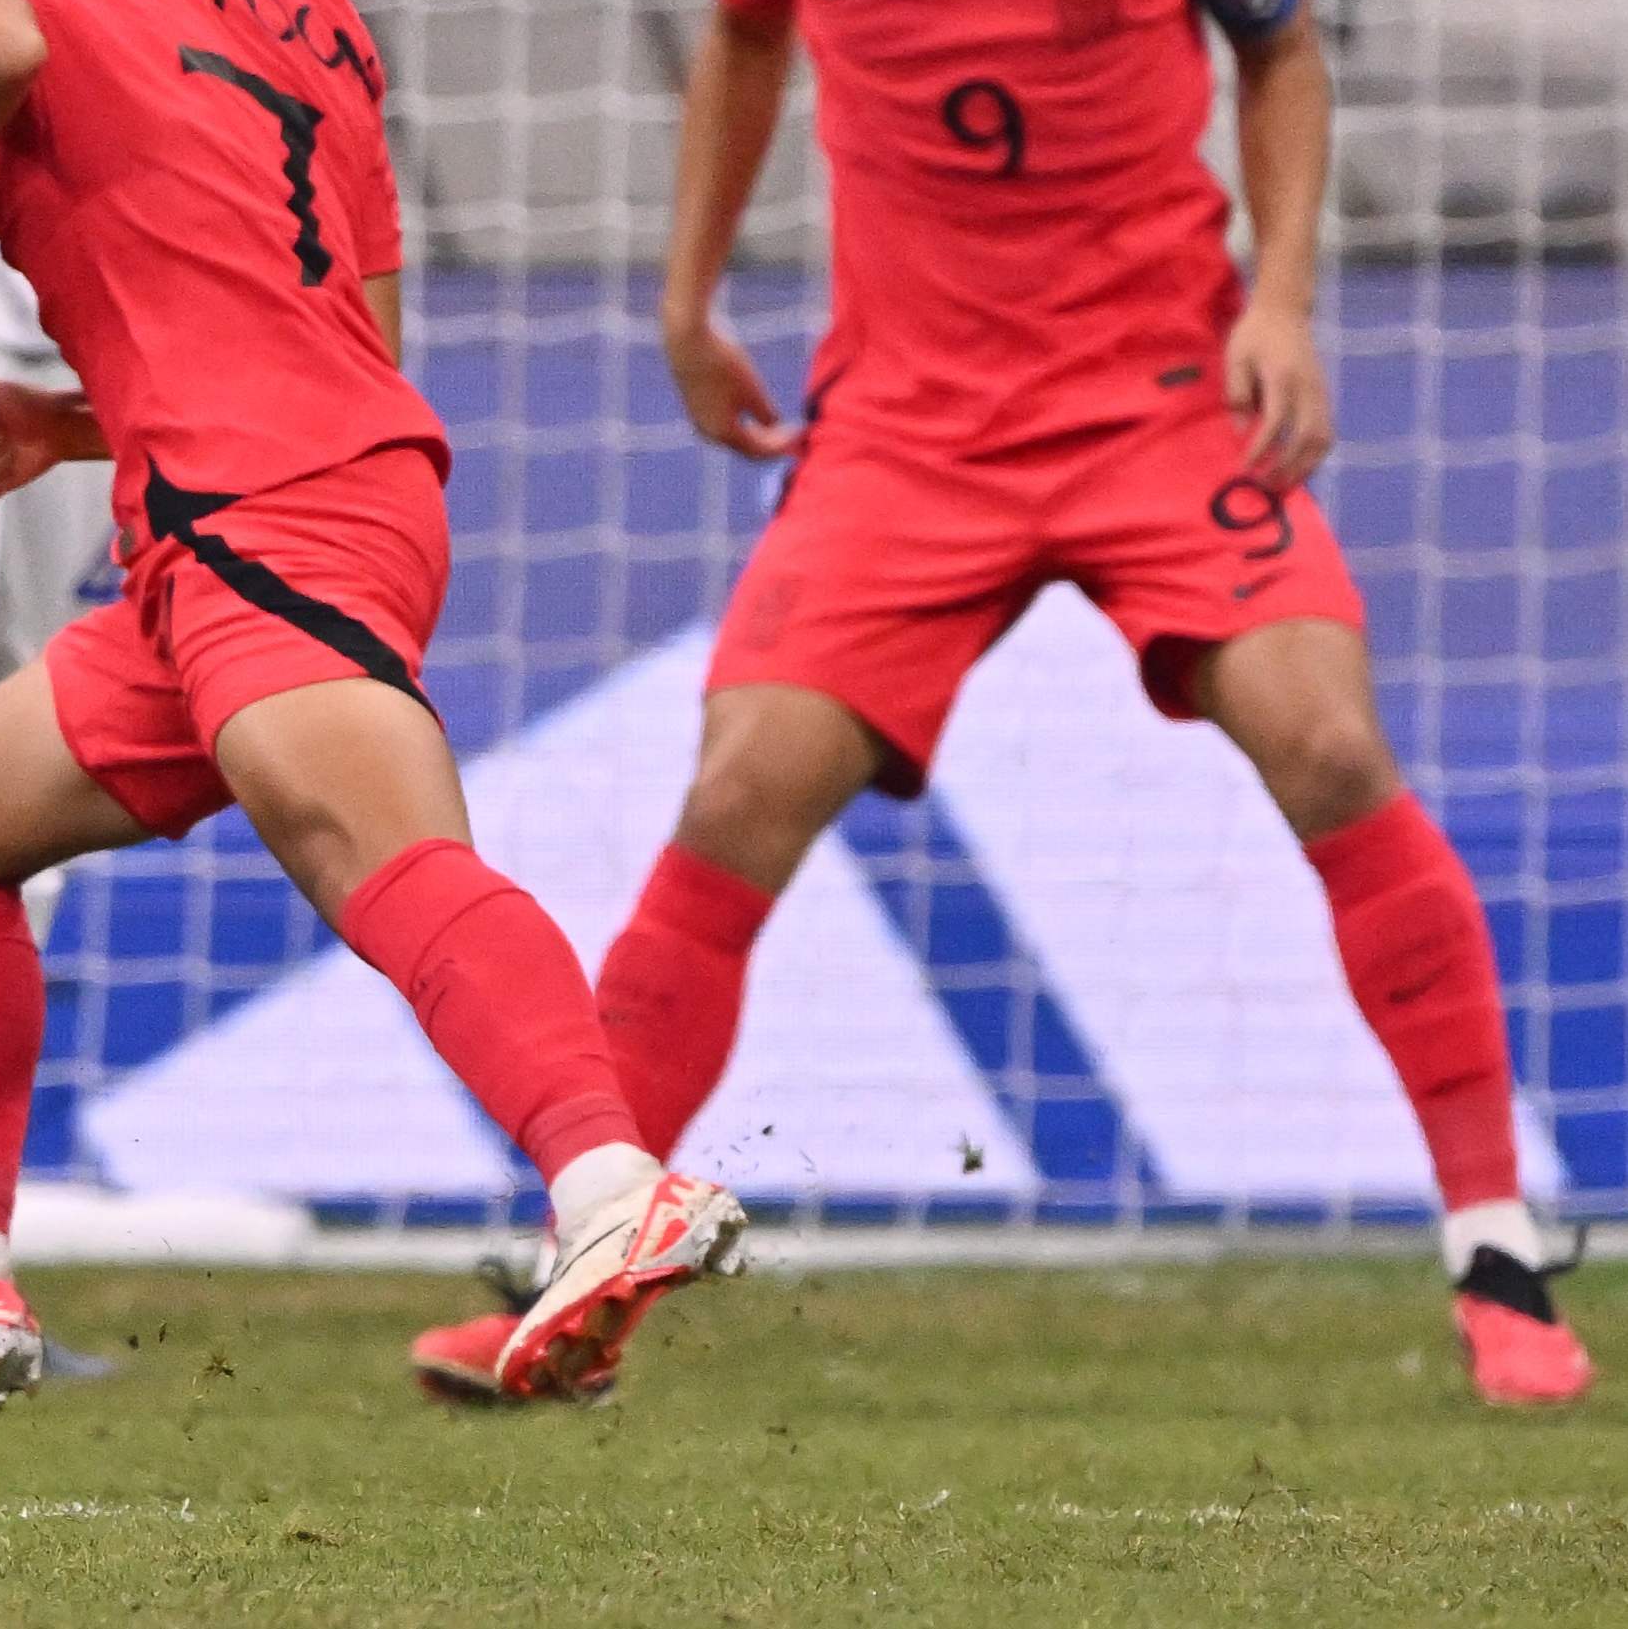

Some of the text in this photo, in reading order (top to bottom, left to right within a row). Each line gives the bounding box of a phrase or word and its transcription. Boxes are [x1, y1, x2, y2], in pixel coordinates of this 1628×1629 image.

[178, 45, 333, 287] 7
[943, 78, 1024, 180] 9
[1210, 478, 1293, 560] 9
